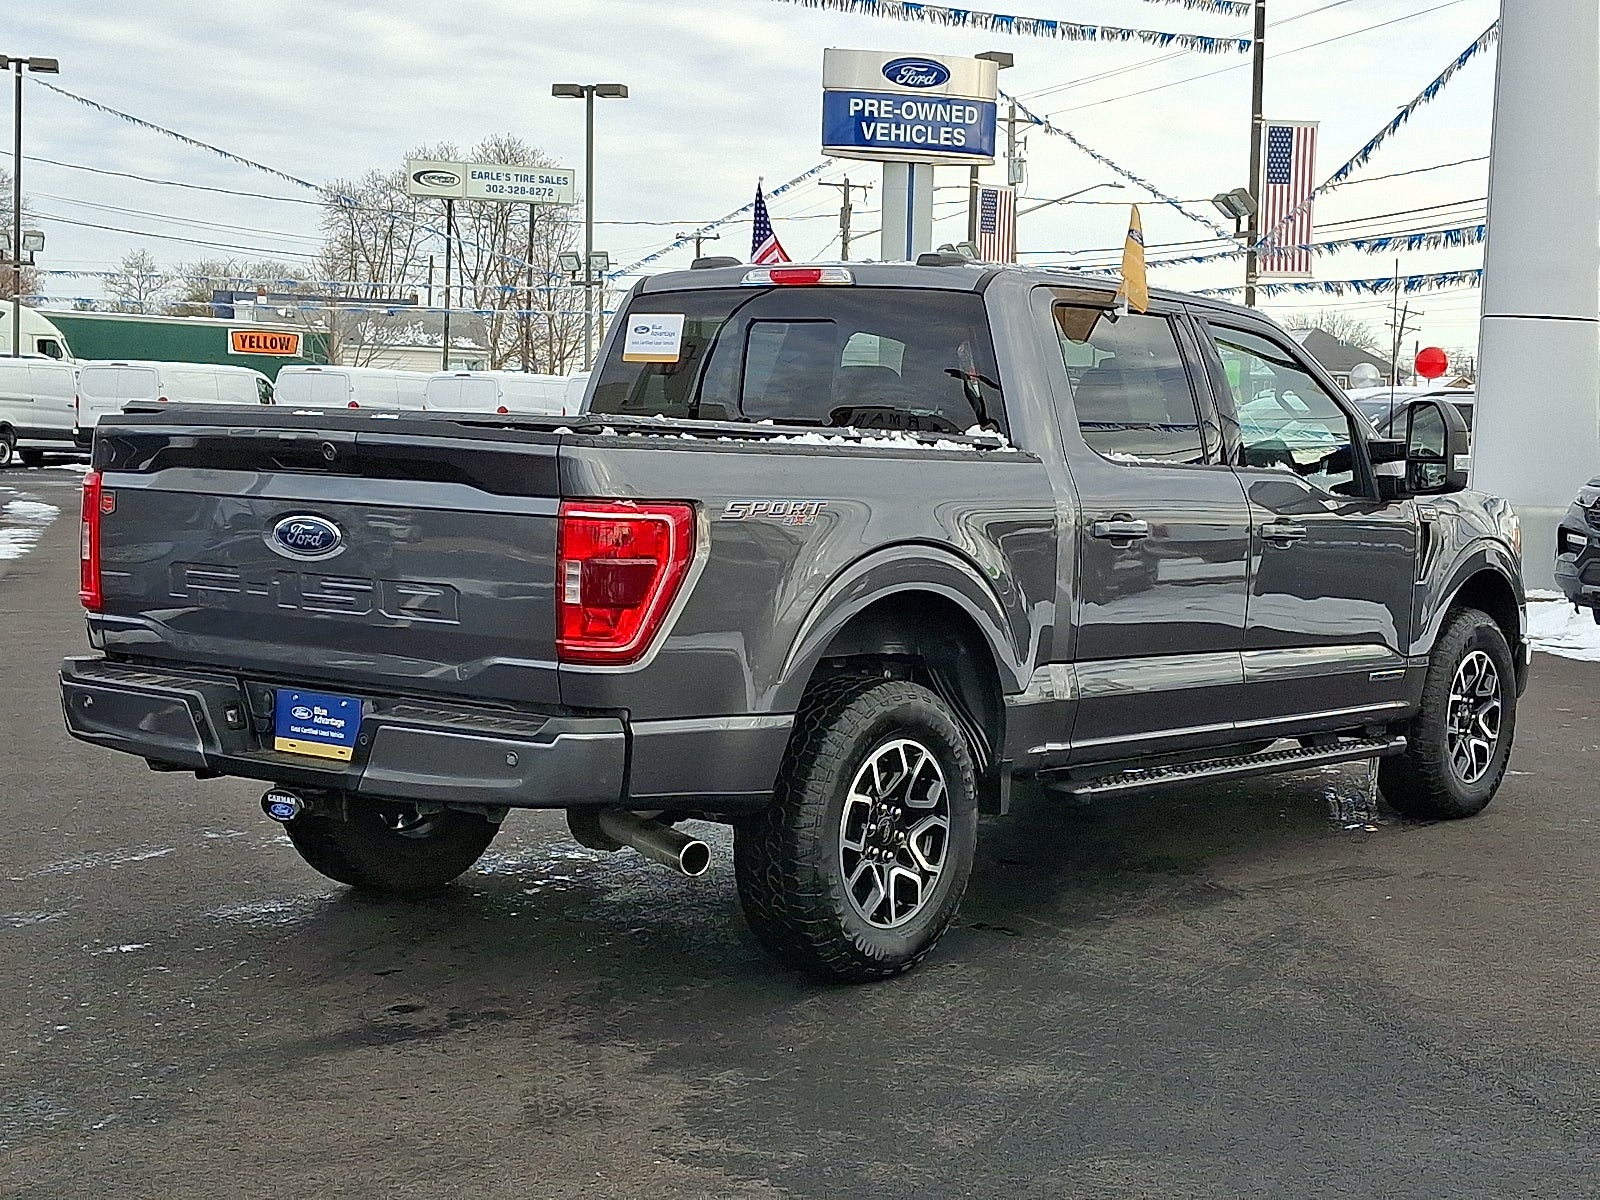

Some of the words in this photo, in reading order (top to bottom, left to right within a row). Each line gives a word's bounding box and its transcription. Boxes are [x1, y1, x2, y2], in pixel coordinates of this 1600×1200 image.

[896, 65, 937, 86] Ford
[849, 98, 979, 124] PRE-OWNED
[861, 121, 966, 146] VEHICLES
[471, 170, 511, 182] EARLE'S
[514, 173, 535, 183] TIRE
[538, 175, 569, 185] SALES
[485, 184, 554, 197] 302-328-8272
[240, 334, 291, 351] YELLOW
[720, 500, 828, 521] SPORT
[286, 523, 324, 548] Ford
